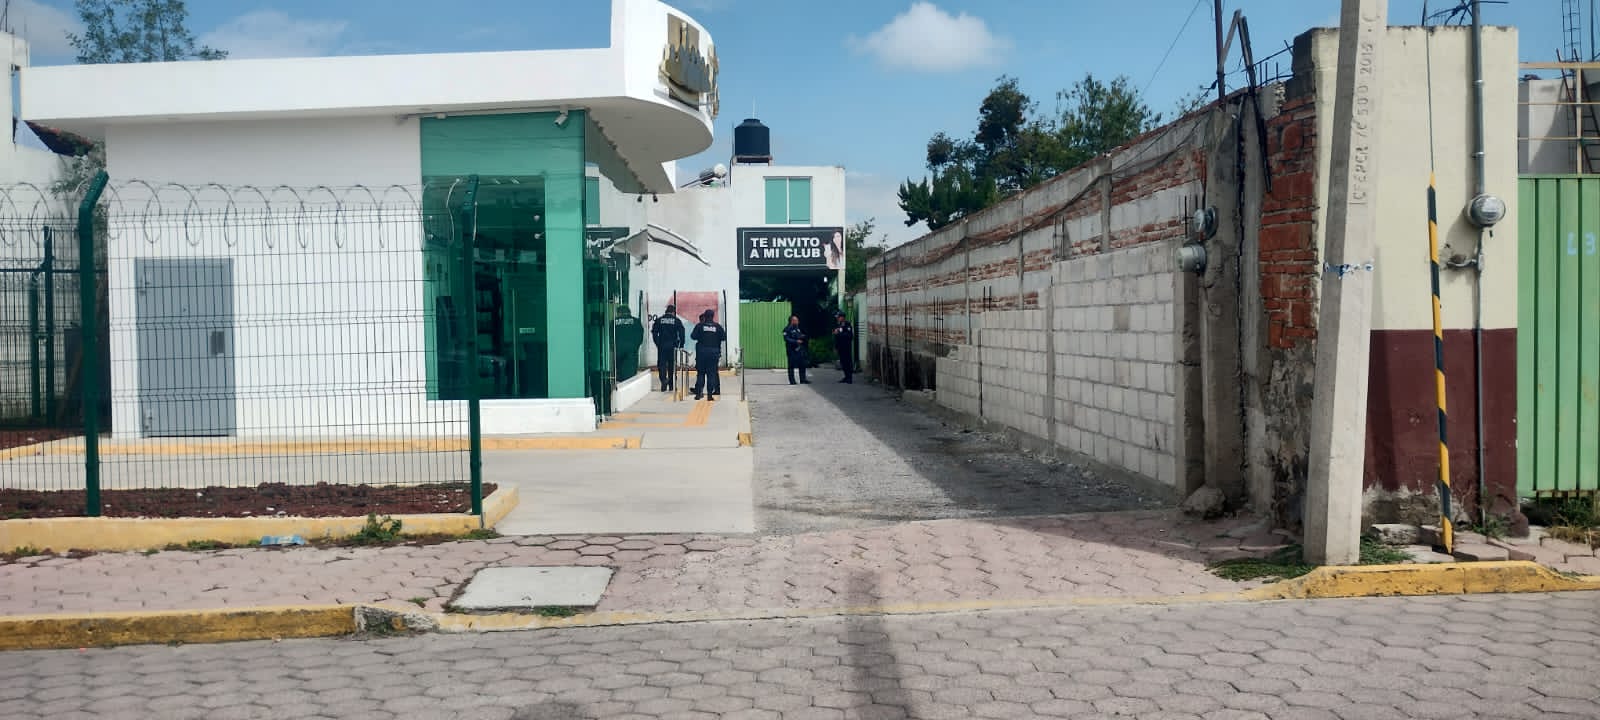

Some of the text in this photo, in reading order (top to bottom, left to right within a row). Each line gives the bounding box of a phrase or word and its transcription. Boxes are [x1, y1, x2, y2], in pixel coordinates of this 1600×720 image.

[750, 237, 820, 247] TE INVITO
[749, 248, 821, 258] A MI CLUB
